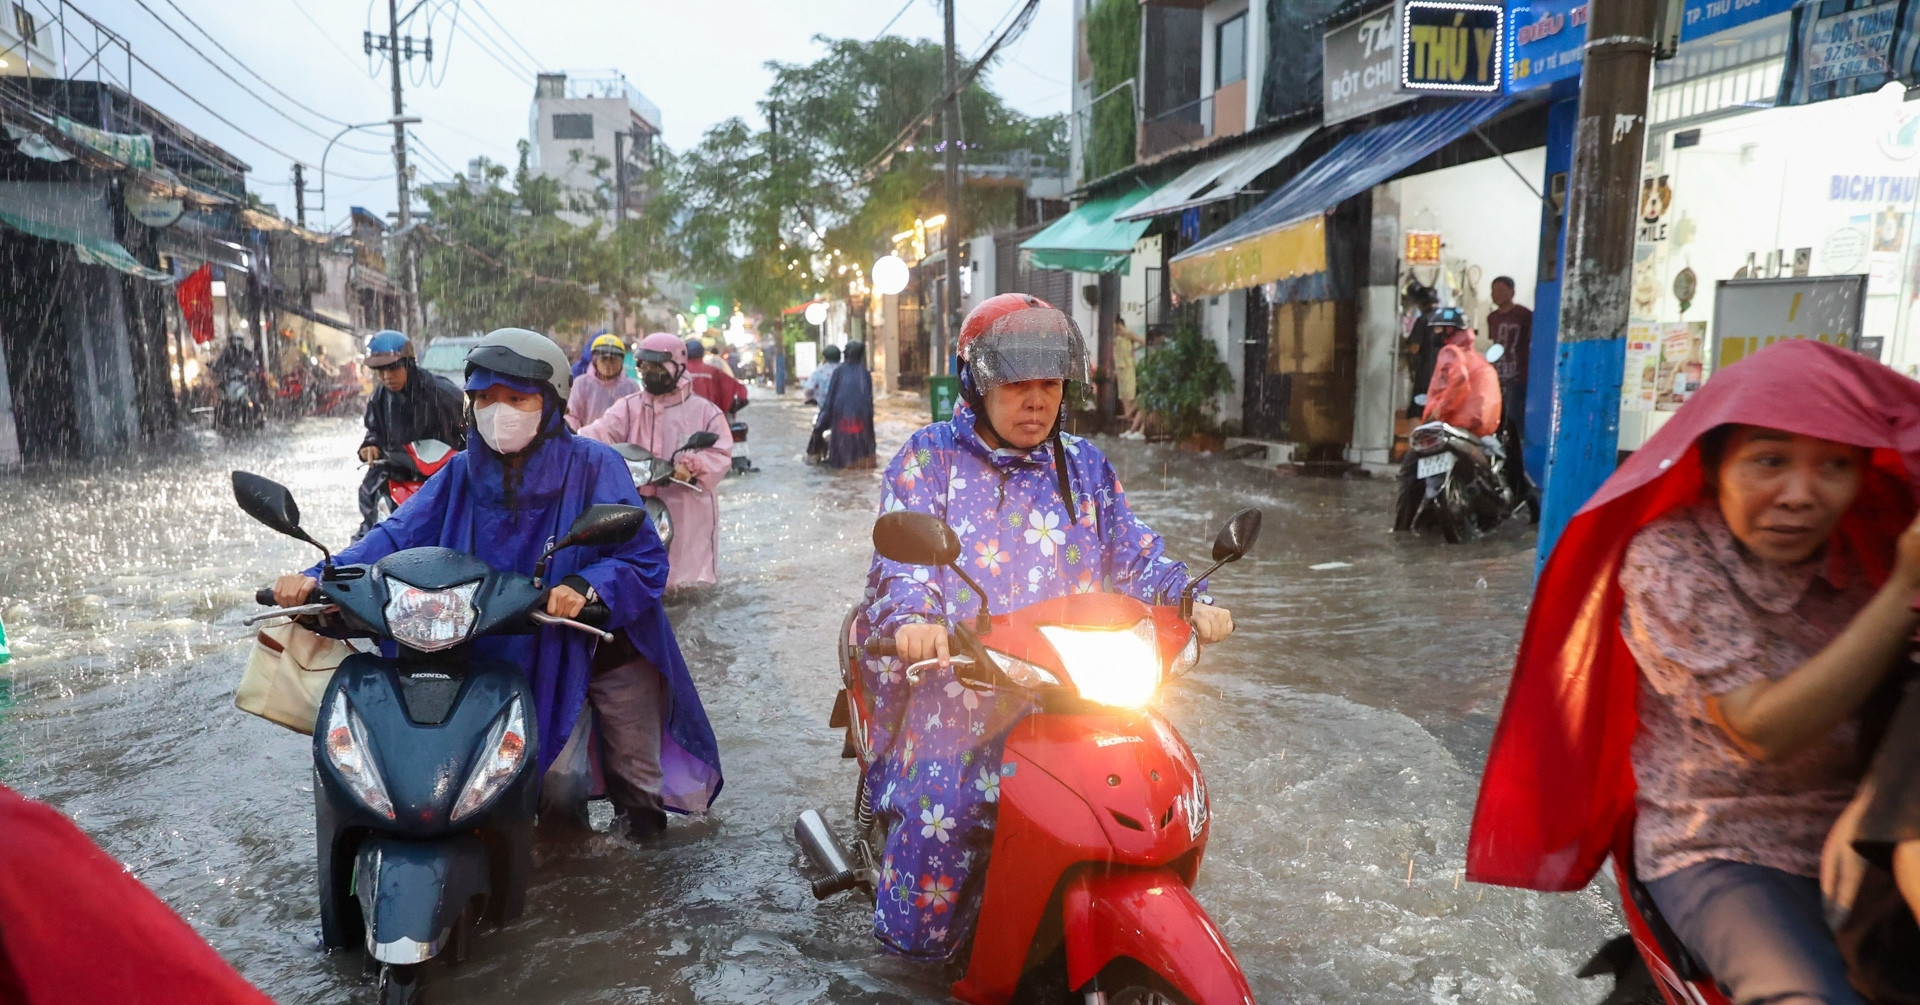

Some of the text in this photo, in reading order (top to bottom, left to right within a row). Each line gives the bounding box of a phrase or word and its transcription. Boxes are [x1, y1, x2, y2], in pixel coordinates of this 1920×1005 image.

[1411, 12, 1495, 82] THÚ Y
[1332, 70, 1360, 102] BỘT
[1094, 736, 1144, 747] HONDA
